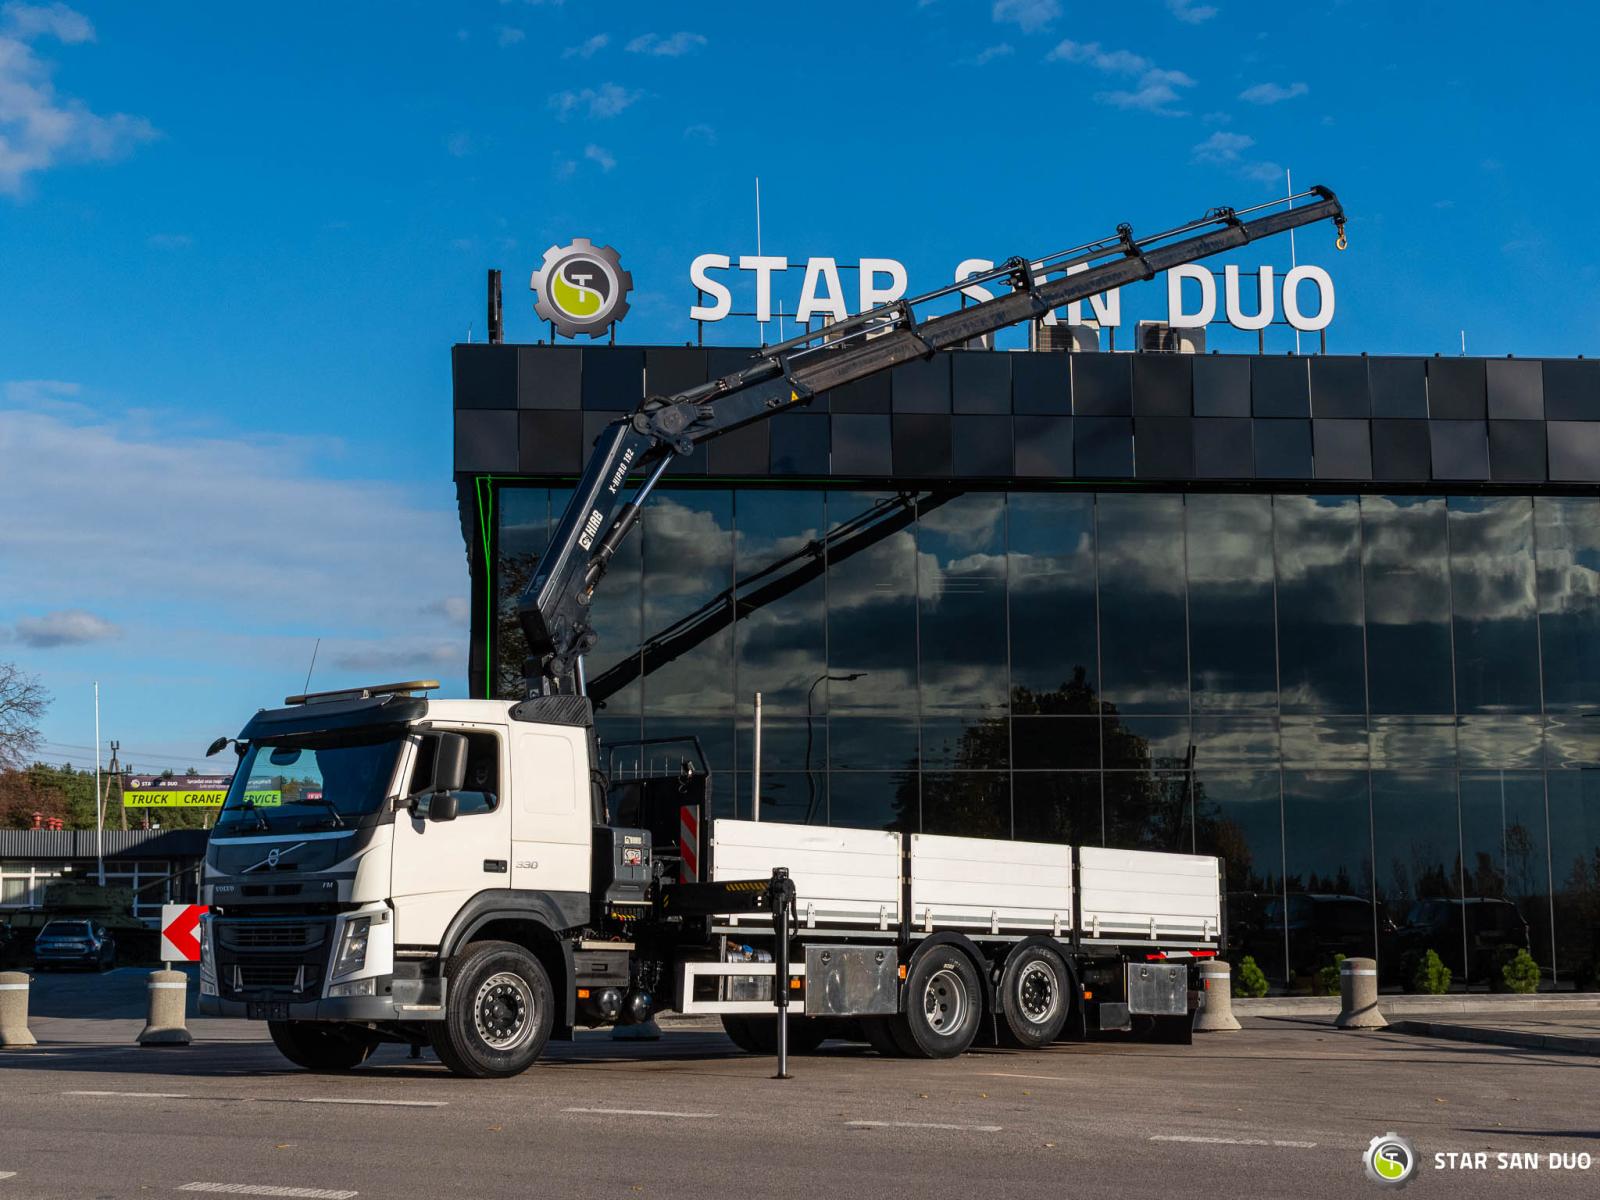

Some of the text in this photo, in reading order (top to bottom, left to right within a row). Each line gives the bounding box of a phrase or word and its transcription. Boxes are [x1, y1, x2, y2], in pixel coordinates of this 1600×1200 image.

[690, 254, 908, 322] STAR
[1168, 264, 1335, 331] DUO
[584, 509, 604, 538] HIAB
[132, 794, 168, 804] TRUCK
[184, 794, 222, 804] CRANE
[515, 861, 539, 870] 330
[322, 881, 334, 889] FM
